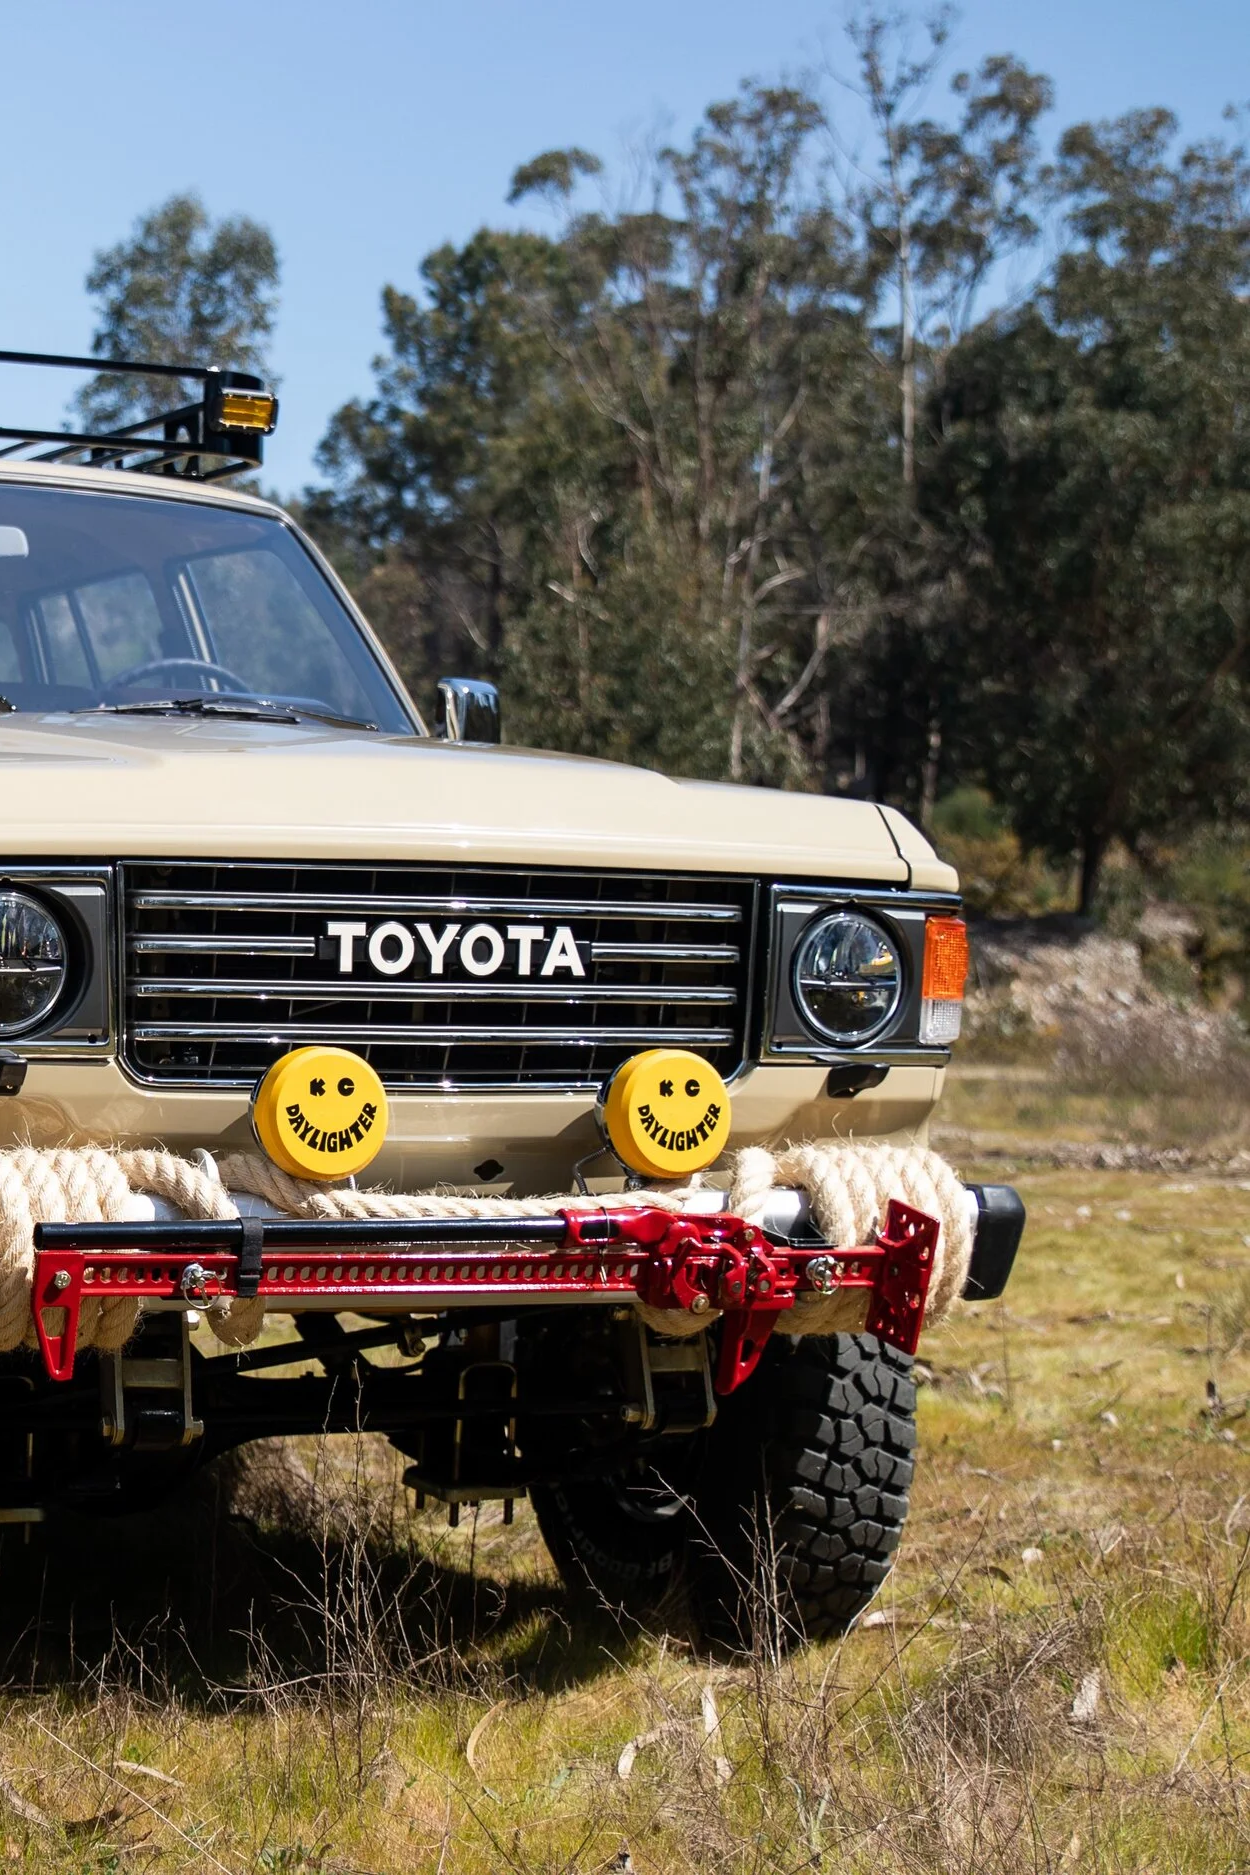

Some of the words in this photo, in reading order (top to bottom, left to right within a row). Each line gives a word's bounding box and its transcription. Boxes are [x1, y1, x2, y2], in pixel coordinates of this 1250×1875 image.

[326, 921, 586, 976] TOYOTA
[285, 1102, 377, 1153] DAYLIGHTER
[637, 1103, 721, 1152] DAYLIGHTER
